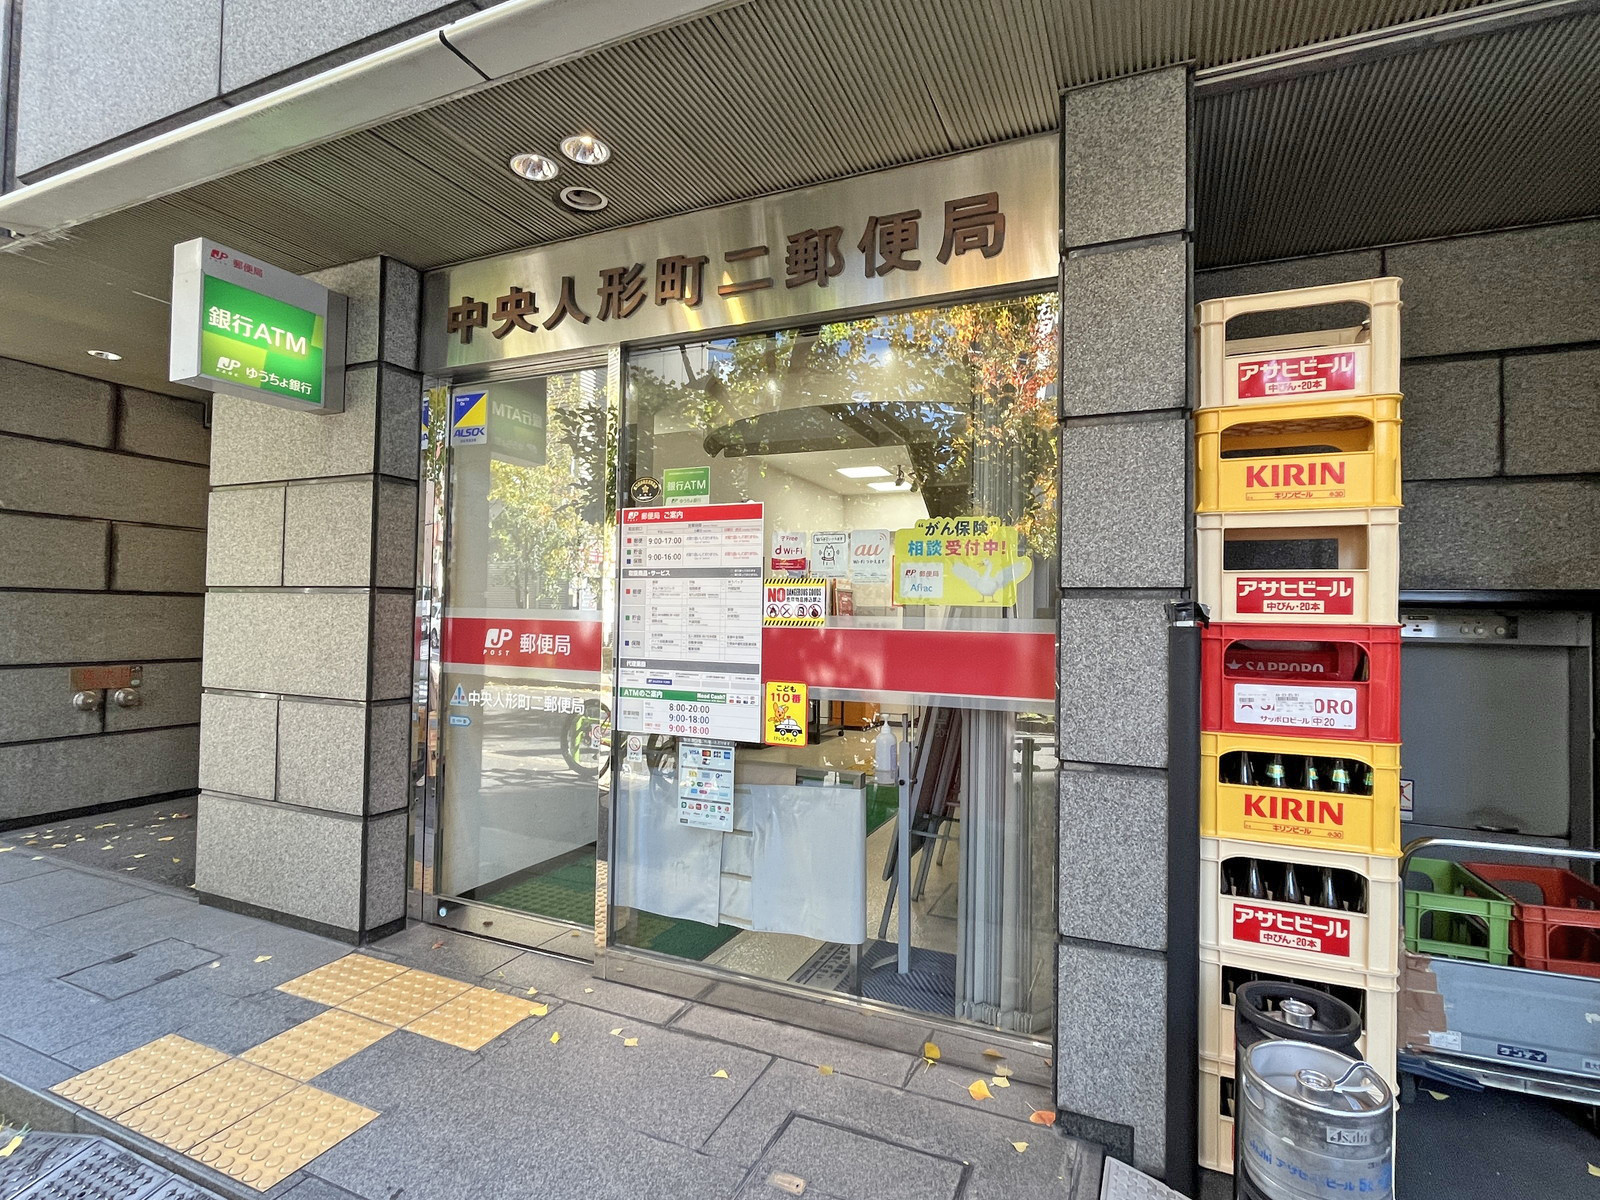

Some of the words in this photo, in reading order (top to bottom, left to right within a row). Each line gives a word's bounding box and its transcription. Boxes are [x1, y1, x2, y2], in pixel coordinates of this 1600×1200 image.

[233, 259, 263, 278] 郵便局
[446, 191, 1006, 345] 中央人形町二郵便局
[208, 305, 307, 355] 銀行ATM
[1240, 355, 1353, 382] アサヒビール
[246, 367, 312, 395] ゆうちょ銀行
[1268, 379, 1323, 392] 中びん・20本
[454, 427, 485, 437] ALSOK
[1246, 461, 1345, 488] KIRIN
[667, 479, 706, 492] 銀行ATM
[1274, 490, 1313, 499] キリンビール
[641, 511, 660, 520] 郵便局
[663, 511, 684, 519] ご案内
[648, 553, 682, 561] 9:00-16:00
[784, 547, 803, 555] Wi-Fi
[854, 544, 884, 557] au
[910, 584, 933, 592] Aflac
[1238, 580, 1351, 598] アサヒビール
[768, 588, 785, 602] NO
[787, 588, 808, 596] DANGEROUS
[1266, 601, 1321, 612] 中びん・20本
[484, 628, 513, 648] JP
[519, 633, 571, 656] 郵便局
[468, 690, 585, 715] 中央人形町二郵便局
[669, 703, 710, 713] 8:00-20:00
[669, 713, 710, 724] 9:00-18:00
[1260, 715, 1310, 724] サッポロビール
[669, 724, 710, 735] 9:00-18:00
[1244, 794, 1343, 826] KIRIN
[1272, 824, 1311, 835] キリンビール
[1235, 907, 1348, 939] アサヒビール
[1263, 933, 1318, 949] 中びん・20本
